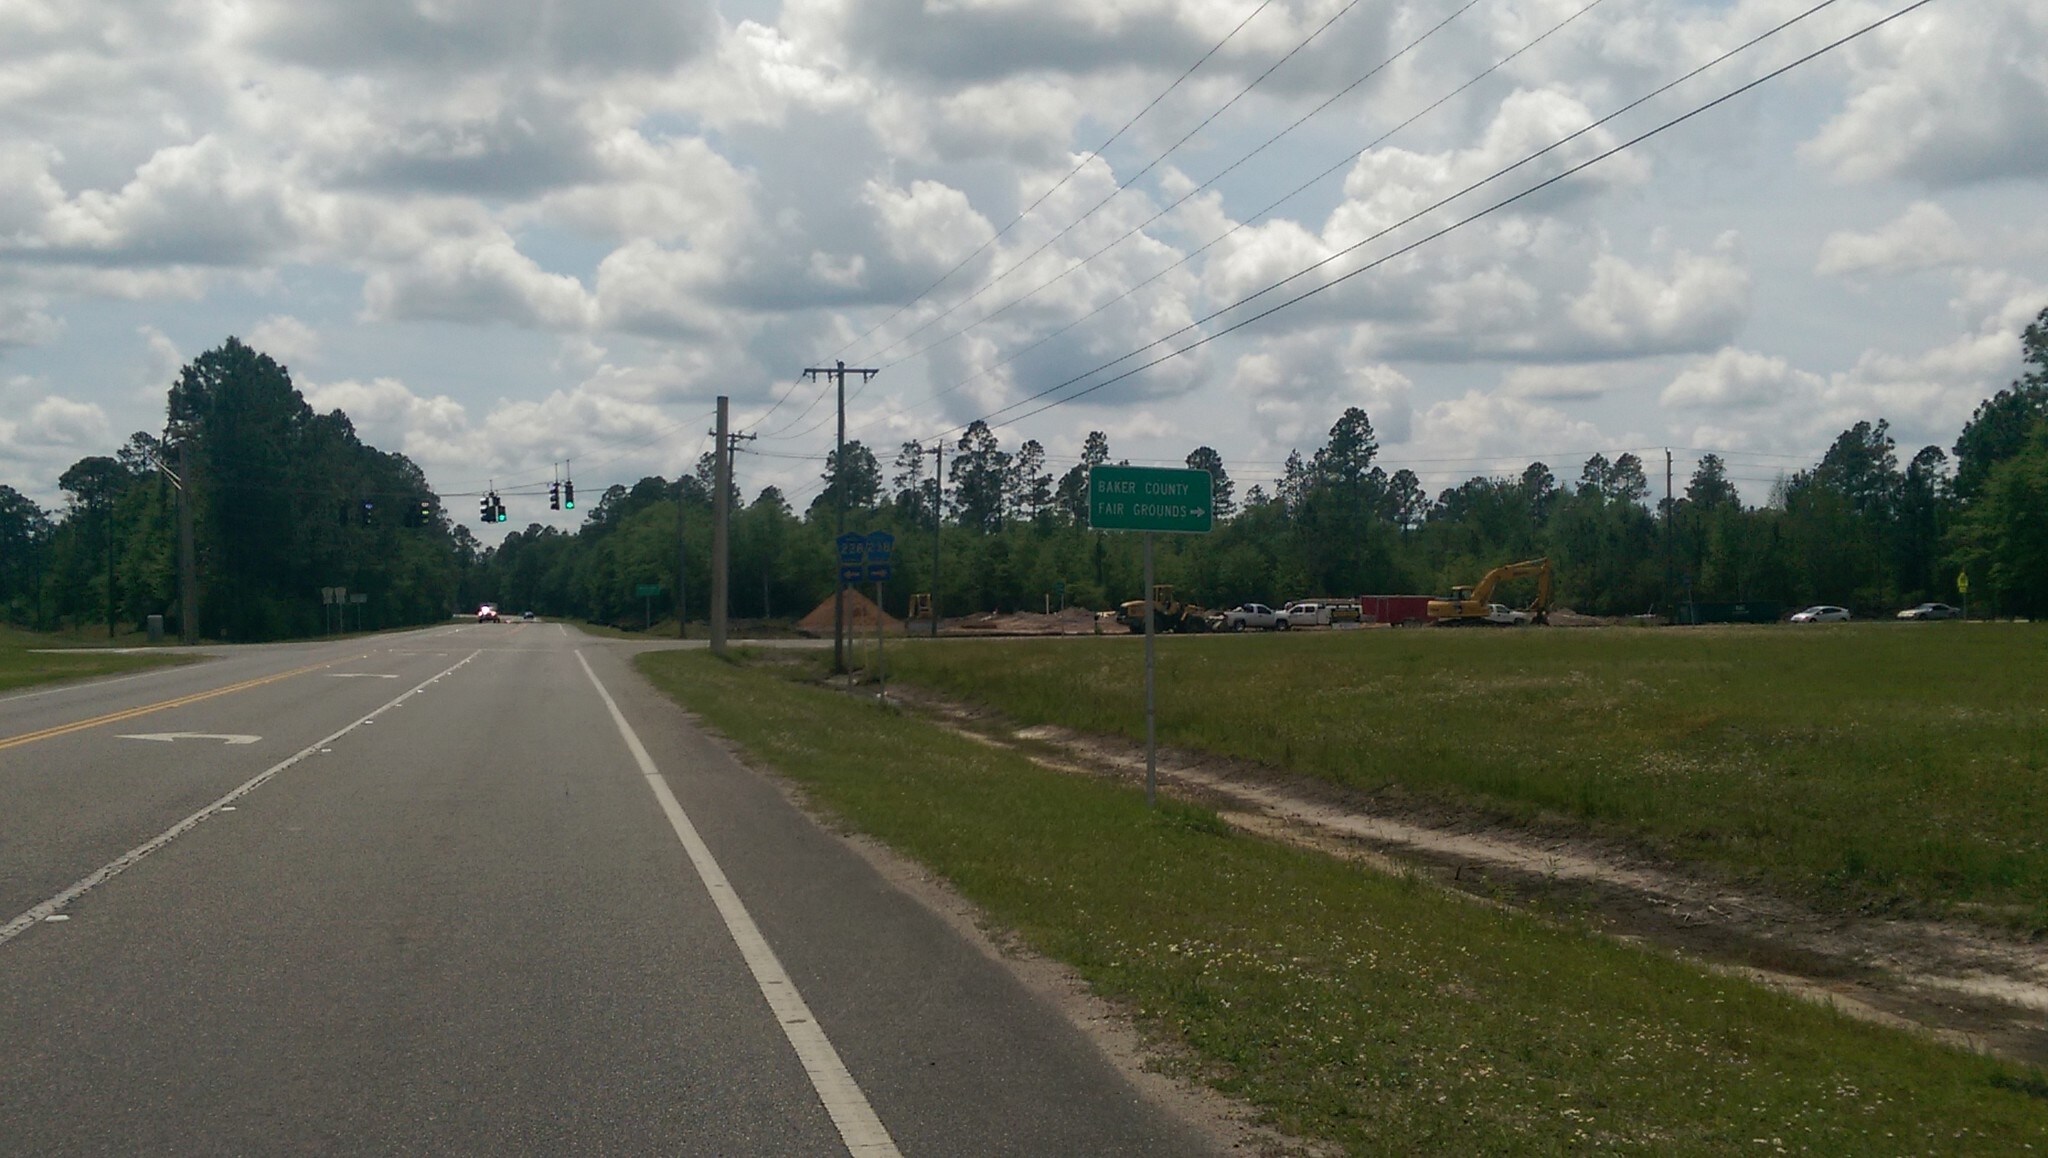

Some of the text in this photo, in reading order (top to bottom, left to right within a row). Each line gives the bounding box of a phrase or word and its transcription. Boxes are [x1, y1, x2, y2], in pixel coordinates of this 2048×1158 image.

[1097, 481, 1189, 495] BAKER COUNTY
[1097, 502, 1187, 517] FAIR GROUNDS
